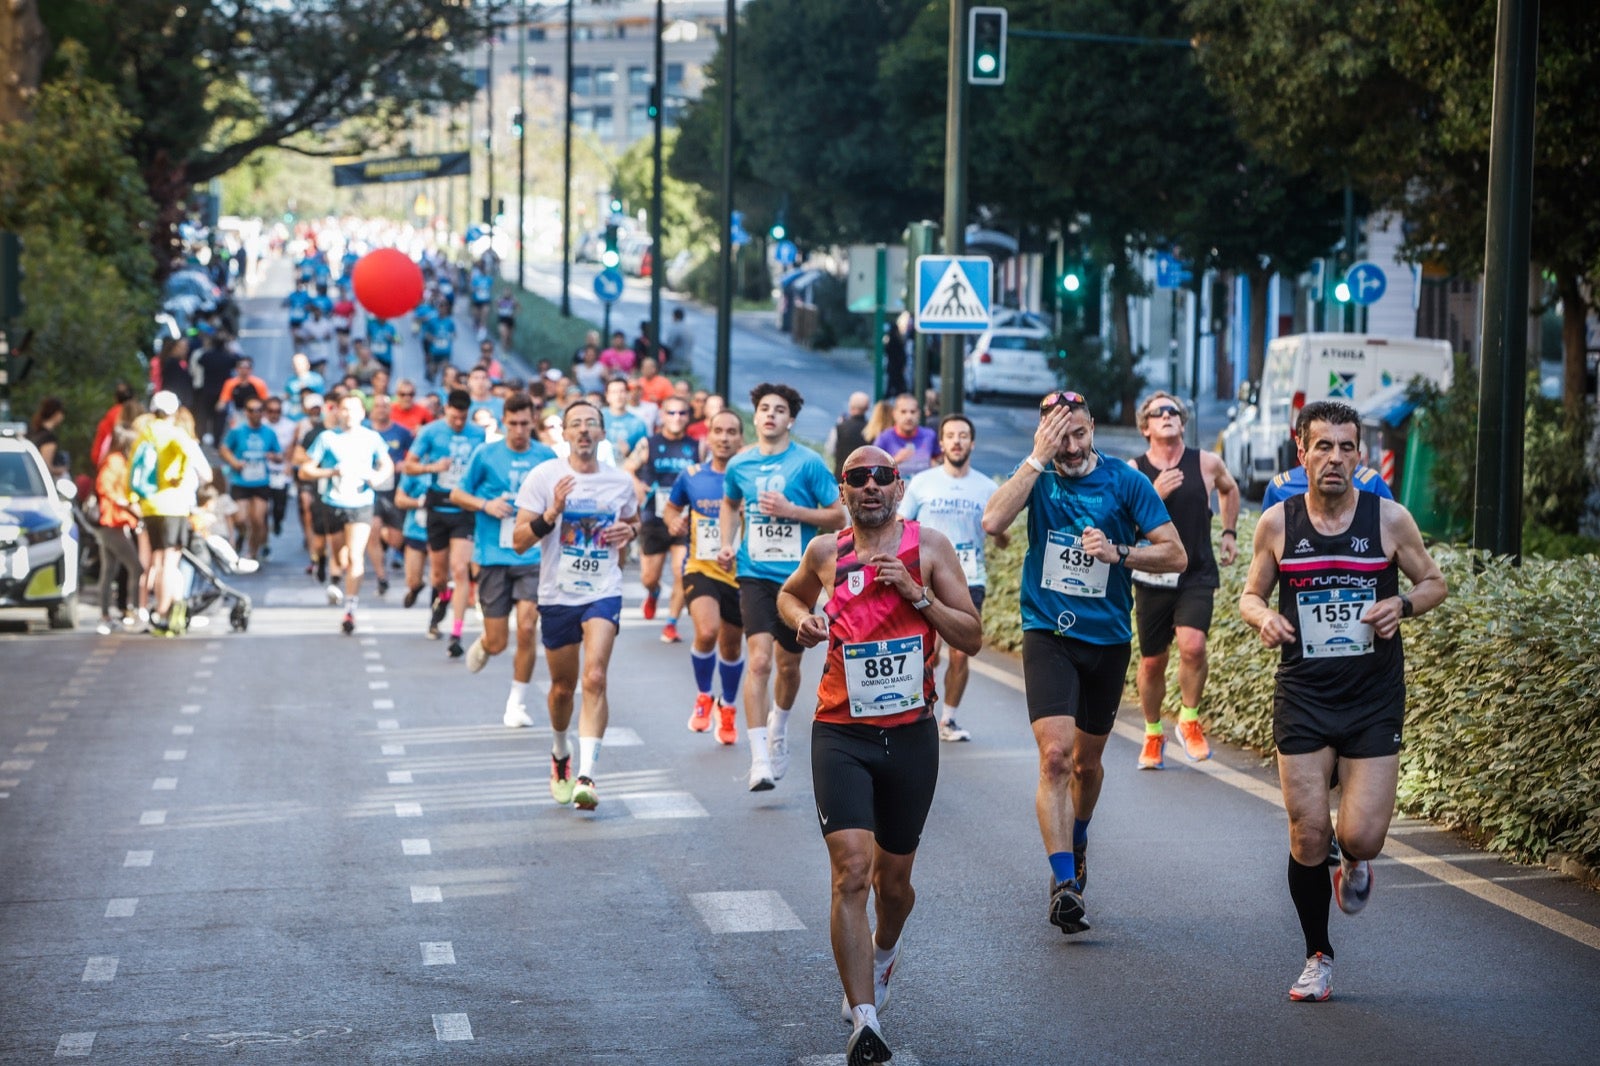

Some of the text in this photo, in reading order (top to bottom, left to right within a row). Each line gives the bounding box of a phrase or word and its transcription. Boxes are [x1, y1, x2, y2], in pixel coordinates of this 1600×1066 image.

[757, 525, 793, 537] 1642
[572, 558, 600, 572] 499
[1059, 548, 1095, 568] 439
[1062, 564, 1078, 573] EMILIO
[1079, 566, 1090, 574] FCO
[1289, 574, 1378, 588] runrundata
[1312, 602, 1365, 623] 1557
[1329, 622, 1349, 630] PABLO
[864, 654, 907, 678] 887
[861, 674, 913, 687] DOMINGO MANUEL
